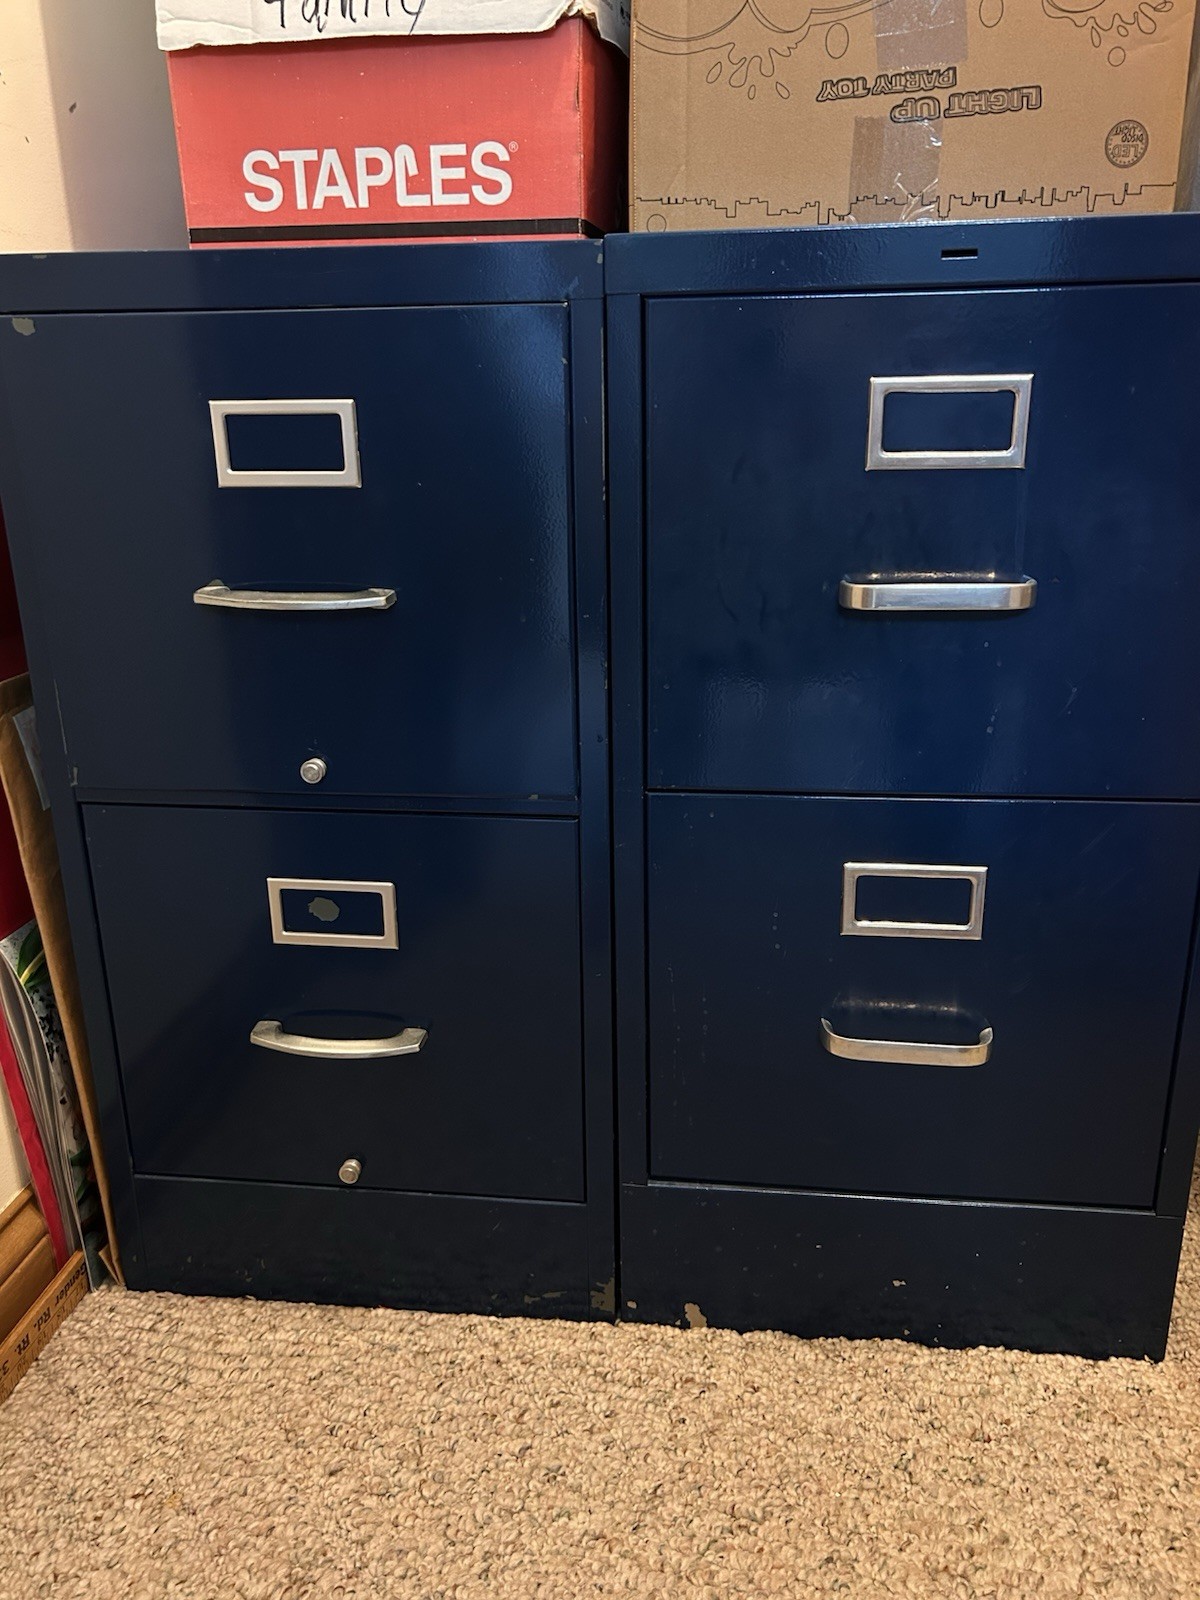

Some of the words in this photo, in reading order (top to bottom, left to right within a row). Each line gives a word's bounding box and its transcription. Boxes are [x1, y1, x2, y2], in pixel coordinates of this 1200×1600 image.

[815, 76, 871, 102] TOY
[871, 66, 957, 96] PARTY
[890, 96, 940, 123] UP
[944, 85, 1042, 118] LIGHT
[1112, 143, 1139, 158] LED
[55, 1261, 87, 1307] Gender
[34, 1307, 52, 1331] Rd.
[14, 1333, 30, 1356] Rt.
